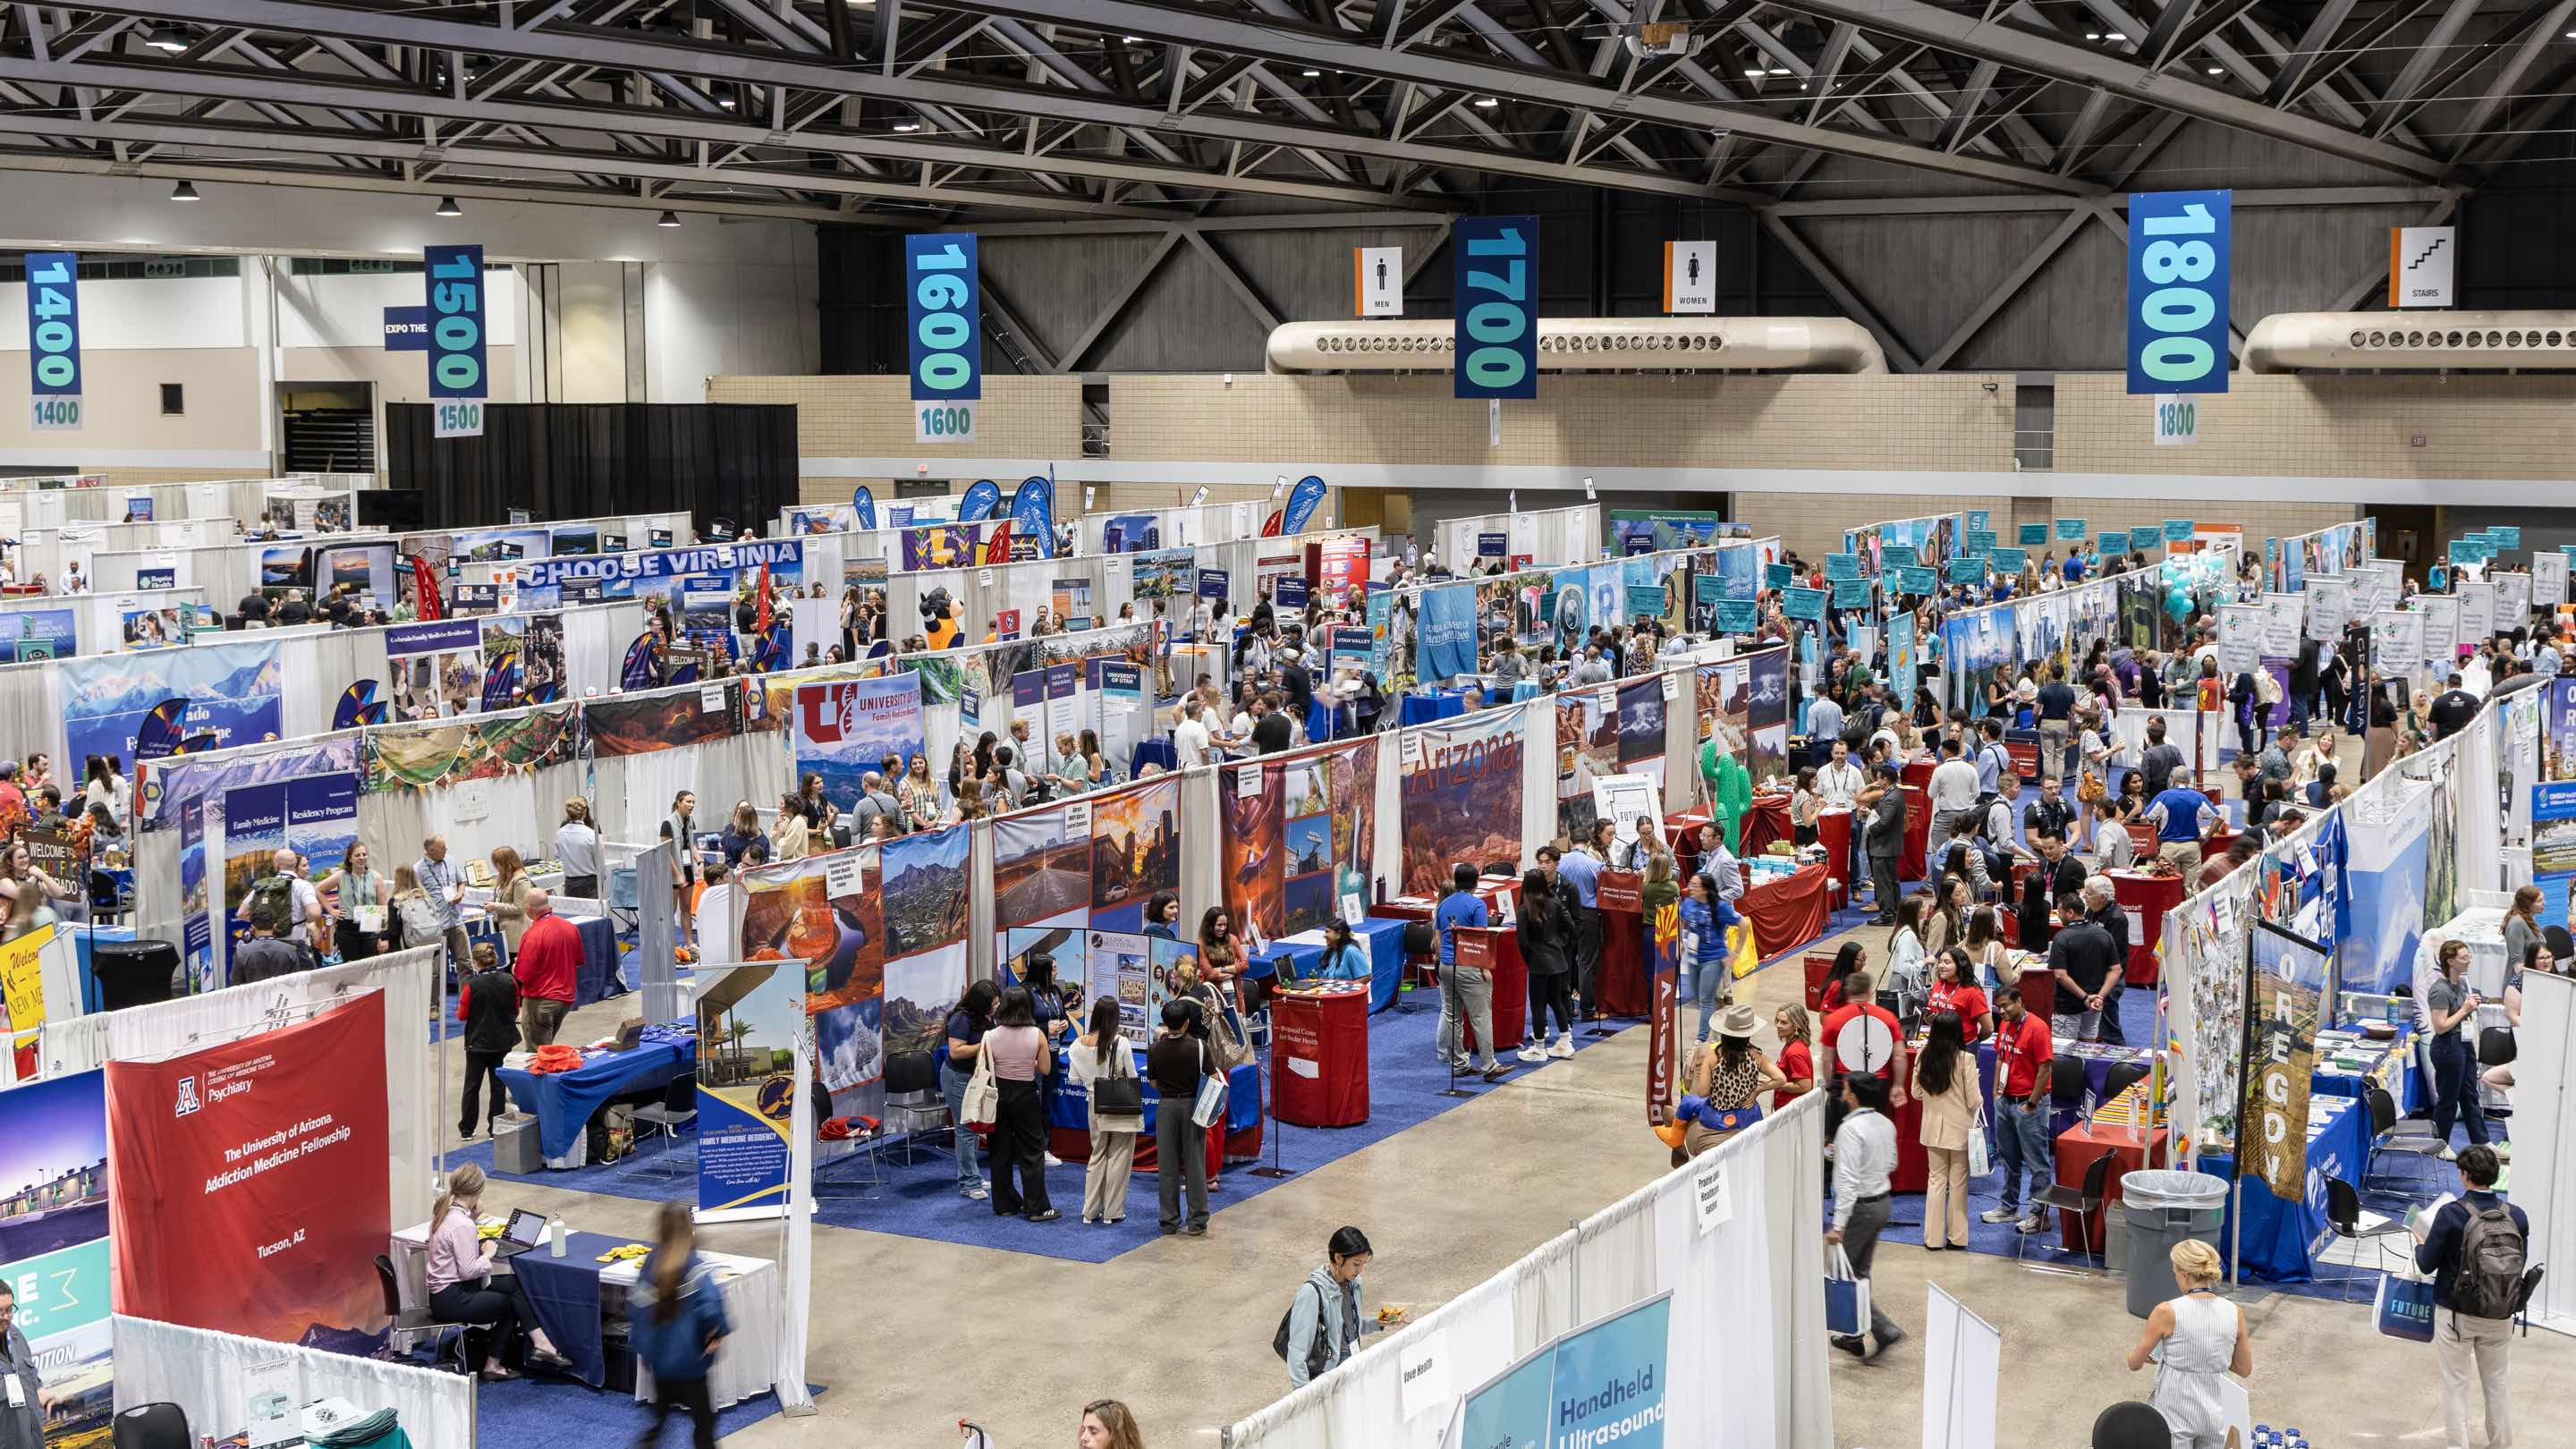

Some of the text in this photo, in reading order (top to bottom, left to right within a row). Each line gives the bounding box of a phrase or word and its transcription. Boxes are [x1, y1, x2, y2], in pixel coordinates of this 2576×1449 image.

[1679, 296, 1707, 305] WOMEN
[2140, 203, 2216, 382] 1800
[2411, 288, 2438, 297] STAIRS
[1374, 300, 1389, 309] MEN
[1465, 227, 1526, 388] 1700
[33, 262, 74, 386] 1400
[433, 255, 479, 389] 1500
[917, 243, 970, 390] 1600
[386, 324, 409, 336] EXPO
[35, 402, 79, 424] 1400
[439, 404, 479, 431] 1500
[921, 407, 970, 436] 1600
[2159, 402, 2195, 436] 1800
[1287, 497, 1312, 535] OKLAHOMA
[667, 543, 798, 572] VIRGINIA
[527, 555, 659, 587] CHOOSE
[1352, 637, 1371, 645] VALLEY
[1107, 672, 1137, 680] UNIVERSITY
[860, 693, 907, 710] UNIVERSITY
[1412, 731, 1517, 793] Arizona
[233, 815, 279, 830] Family Medicine
[292, 805, 353, 820] Residency Program
[29, 842, 65, 858] WELCOME
[1463, 947, 1481, 955] Network
[9, 996, 30, 1015] NEW
[1301, 1037, 1318, 1046] Health
[208, 1070, 217, 1078] THE
[217, 1063, 243, 1076] UNIVERSITY
[251, 1055, 273, 1066] ARIZONA
[208, 1075, 226, 1085] COLLEGE
[234, 1065, 258, 1078] MEDICINE
[208, 1079, 253, 1103] Psychiatry
[1065, 1088, 1088, 1097] Medicin
[225, 1148, 242, 1163] The
[242, 1130, 287, 1157] University
[288, 1126, 298, 1140] of
[700, 1132, 776, 1146] FAMILY MEDICINE RESIDENCY
[205, 1125, 351, 1195] Addiction Medicine Fellowship
[258, 1227, 306, 1259] Tucson, AZ
[2390, 1300, 2430, 1319] FUTURE
[1560, 1364, 1653, 1426] Handheld
